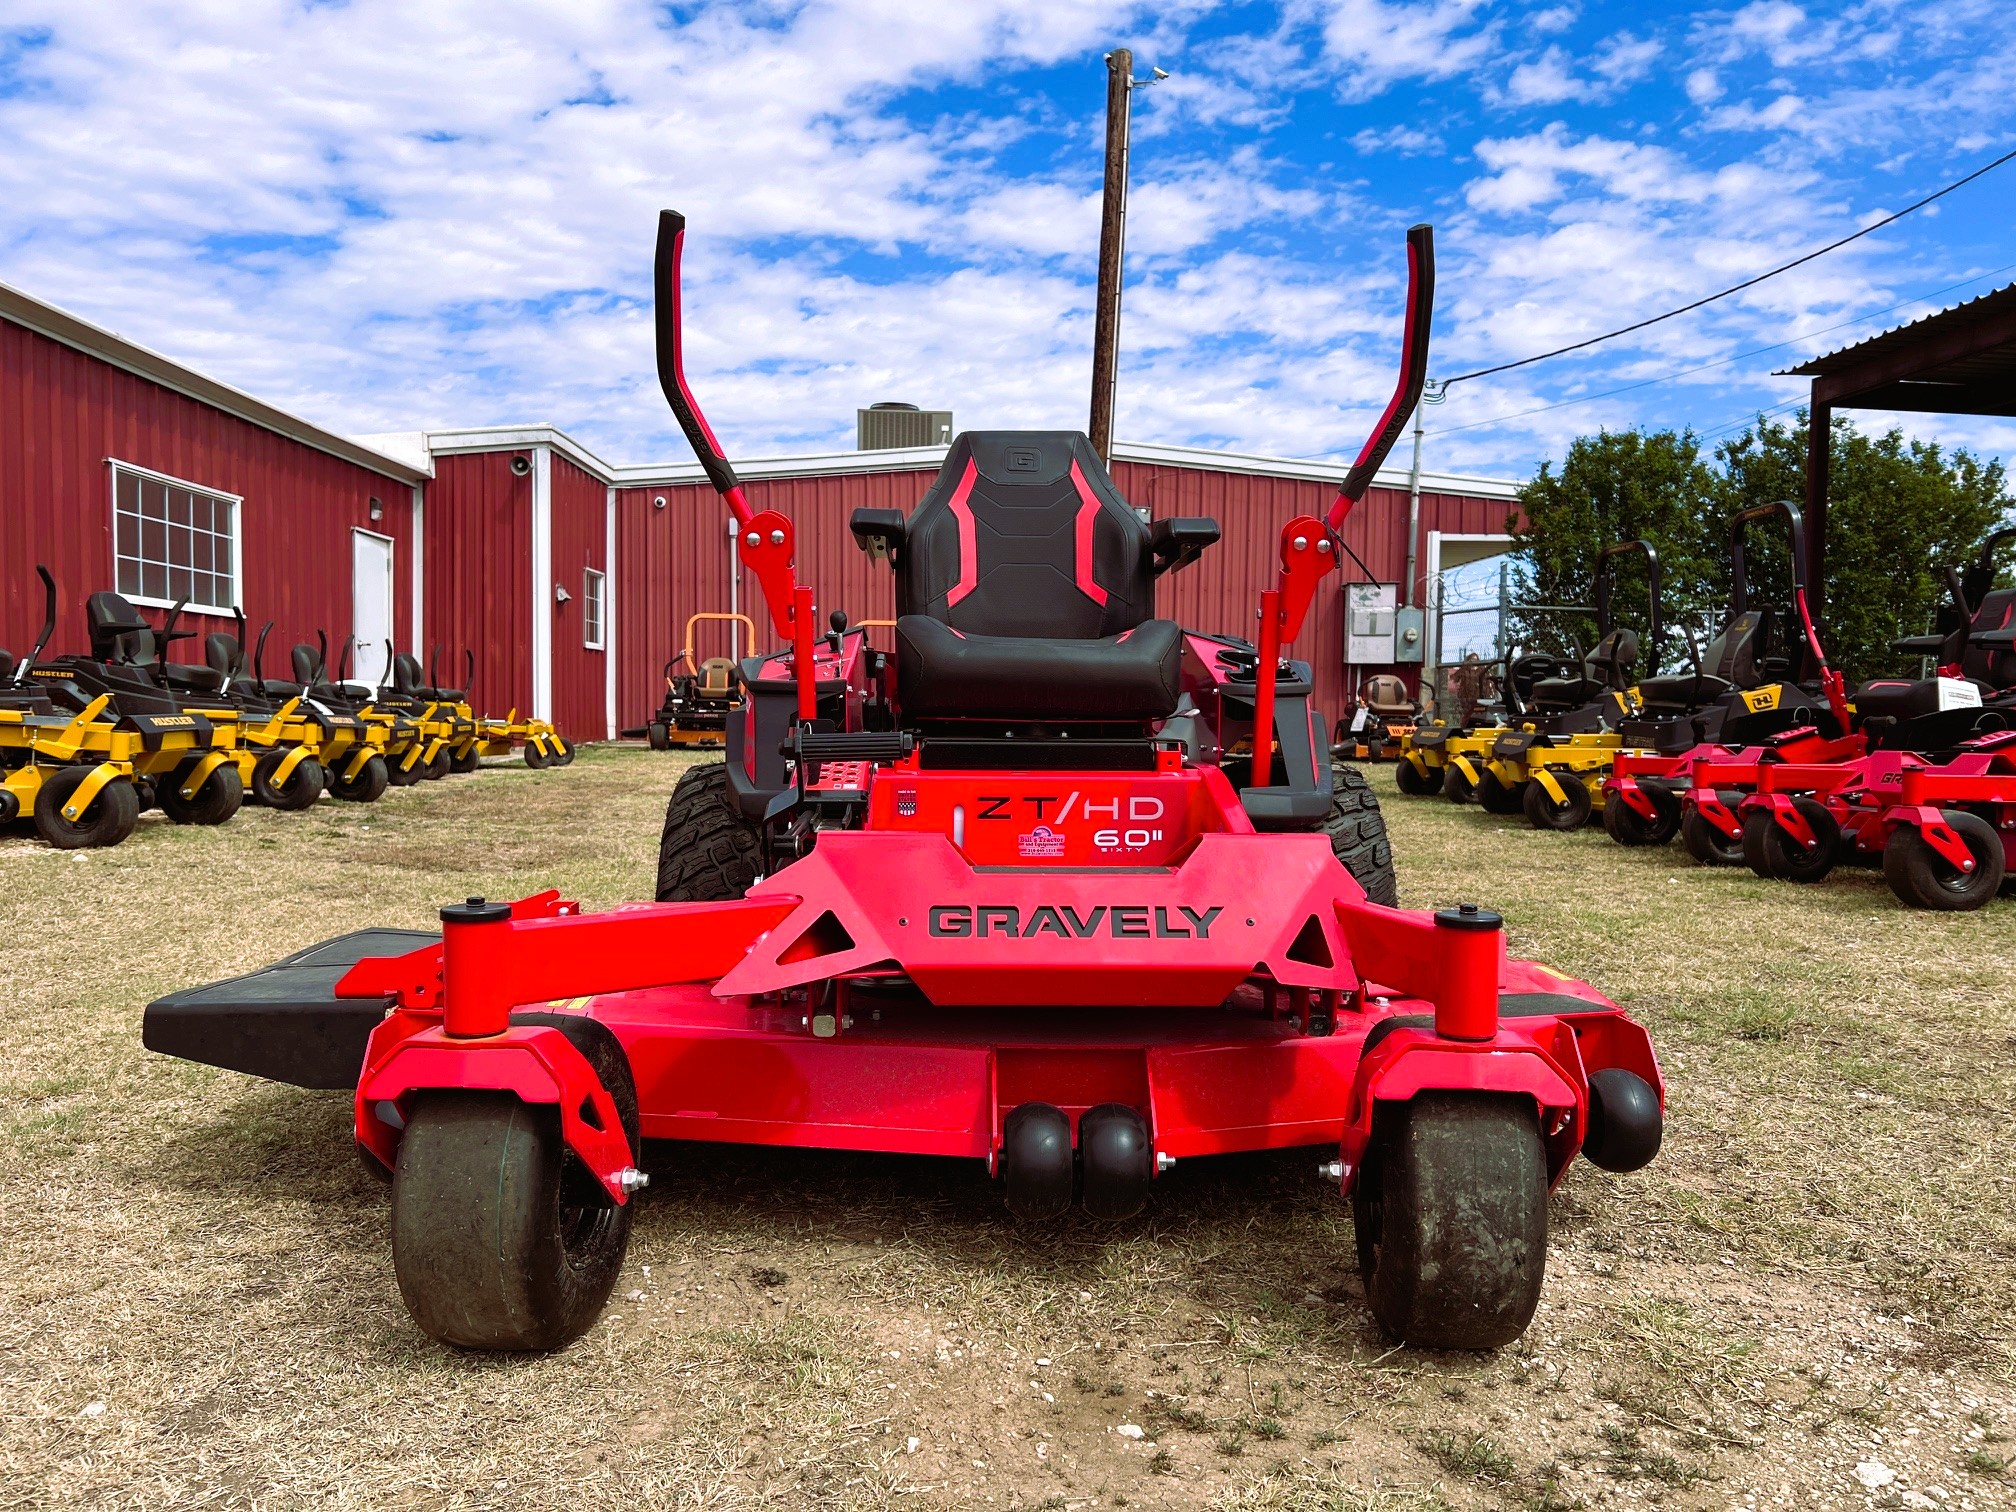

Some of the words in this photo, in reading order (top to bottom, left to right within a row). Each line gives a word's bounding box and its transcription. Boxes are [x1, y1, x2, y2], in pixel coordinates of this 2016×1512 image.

[1371, 405, 1408, 462] GRAVELY
[32, 670, 75, 678] HUSTLER
[149, 716, 196, 727] HUSTLER
[1093, 829, 1163, 847] 60"
[928, 905, 1225, 939] GRAVELY
